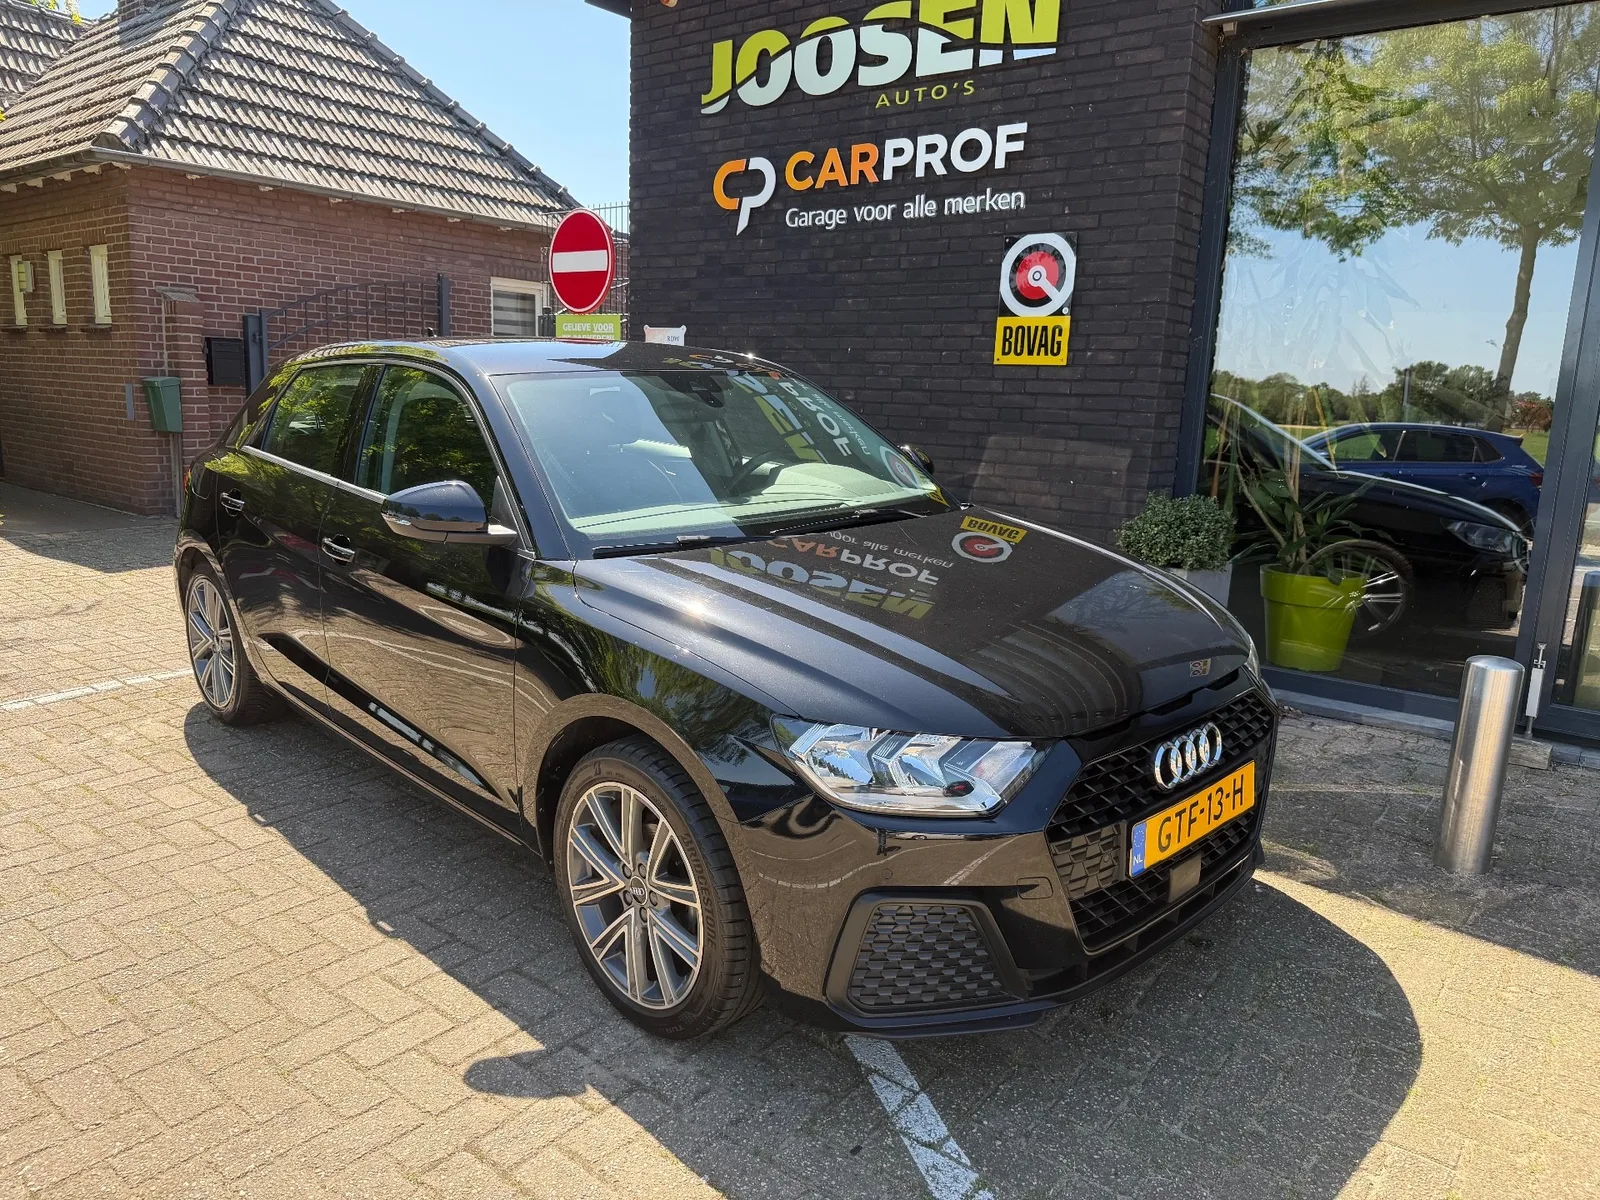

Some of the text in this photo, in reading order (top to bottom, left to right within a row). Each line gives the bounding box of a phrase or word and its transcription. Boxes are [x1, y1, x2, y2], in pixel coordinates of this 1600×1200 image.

[700, 0, 1061, 115] JOOSEN
[875, 80, 975, 109] AUTO'S
[785, 122, 1028, 191] CARPROF
[785, 188, 1026, 230] Garage voor alle merken
[563, 323, 614, 332] GELIEVE VOOR
[1001, 325, 1063, 356] BOVAG
[1158, 774, 1245, 852] GTF-13-H
[1133, 853, 1144, 865] NL
